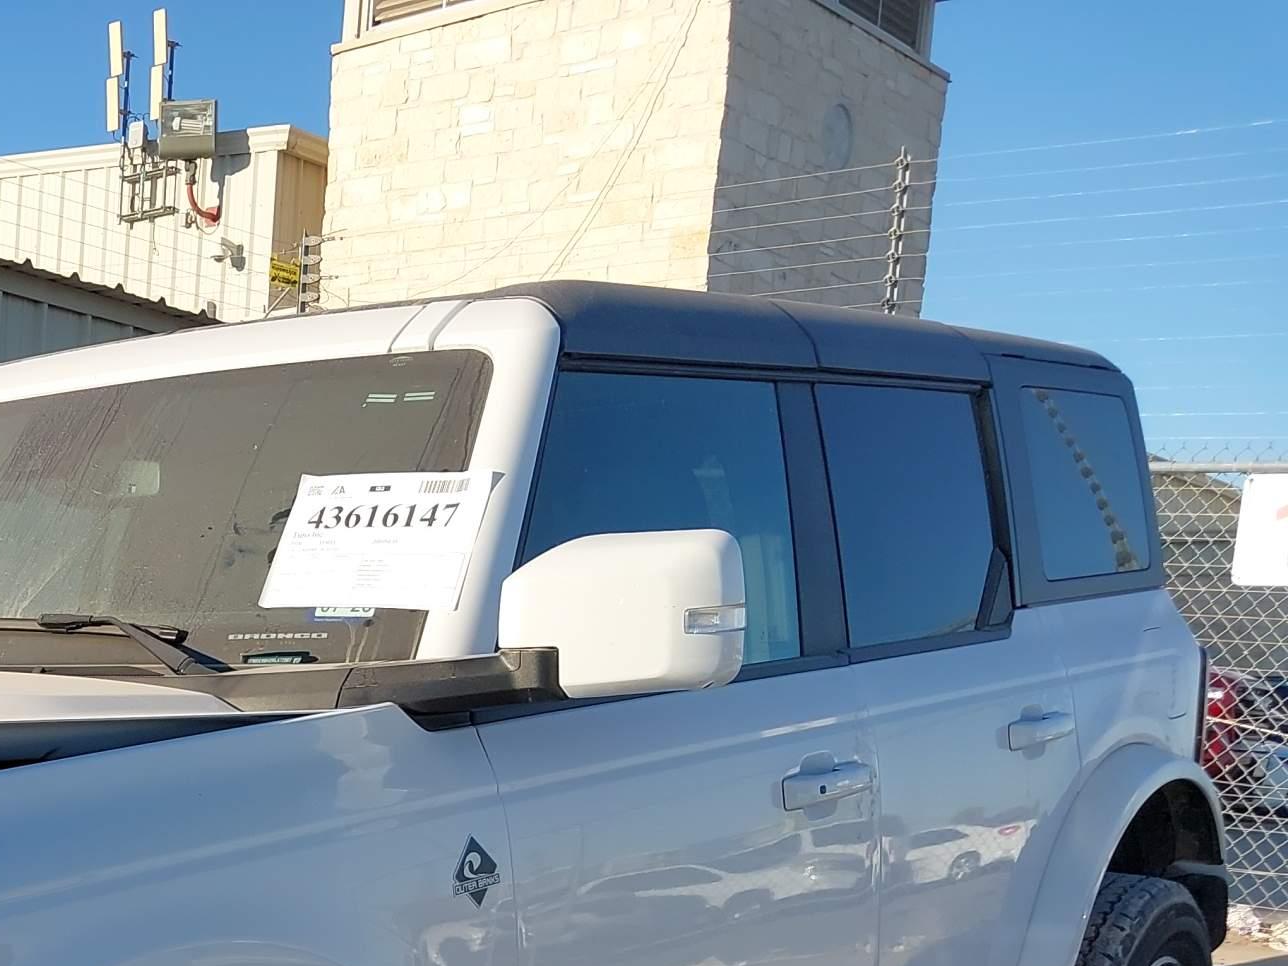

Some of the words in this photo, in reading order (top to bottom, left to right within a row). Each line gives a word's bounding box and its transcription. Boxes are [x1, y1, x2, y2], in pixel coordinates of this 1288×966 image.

[308, 502, 461, 529] 43616147
[455, 882, 478, 894] OUTER
[478, 874, 500, 888] BANKS
